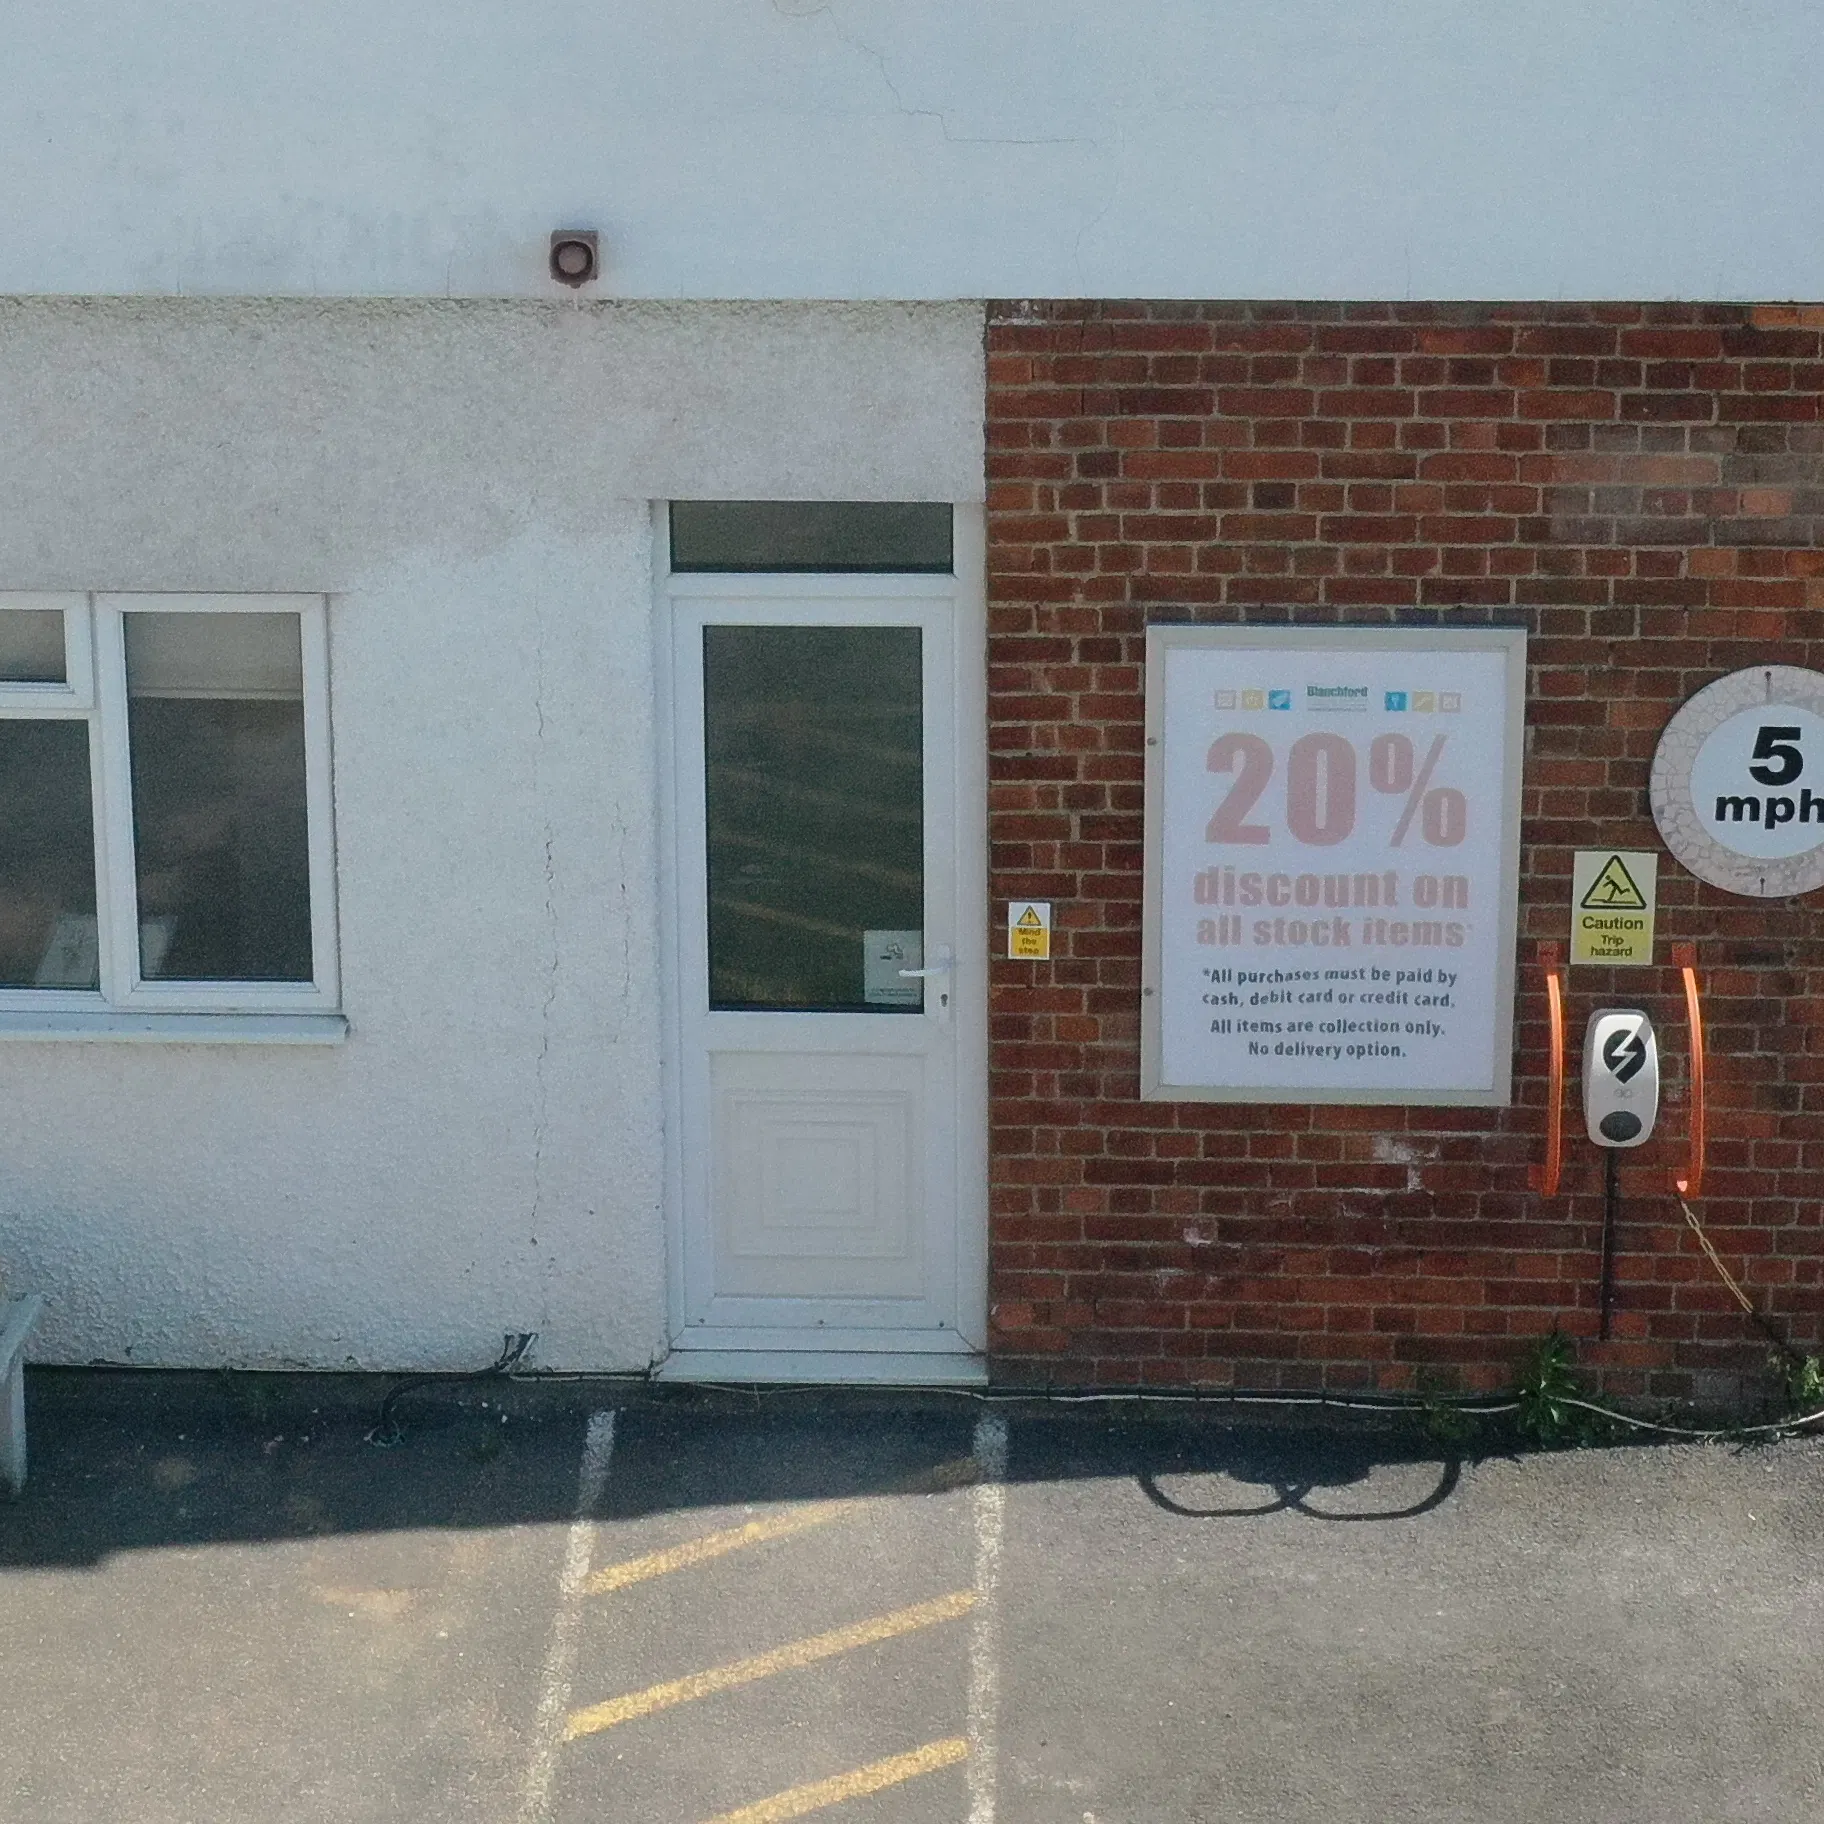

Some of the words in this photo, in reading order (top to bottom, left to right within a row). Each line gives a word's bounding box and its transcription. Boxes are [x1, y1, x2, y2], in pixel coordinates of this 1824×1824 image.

[1749, 726, 1804, 786] 5
[1205, 731, 1467, 847] 20%
[1194, 865, 1399, 908] discount
[1412, 874, 1469, 908] on
[1197, 915, 1242, 946] all
[1253, 916, 1351, 947] stock
[1582, 916, 1644, 931] Caution
[1601, 934, 1624, 947] Trip
[1590, 946, 1633, 957] hazard
[1237, 969, 1320, 986] purchases
[1324, 967, 1366, 980] must
[1370, 965, 1391, 981] be
[1396, 967, 1433, 985] paid
[1437, 968, 1457, 987] by
[1202, 991, 1244, 1007] cash,
[1249, 989, 1292, 1005] debit
[1298, 988, 1333, 1004] card
[1337, 992, 1355, 1004] or
[1359, 990, 1409, 1005] credit
[1413, 992, 1455, 1008] card.
[1210, 1018, 1232, 1034] All
[1236, 1018, 1282, 1033] items
[1286, 1020, 1314, 1033] are
[1319, 1018, 1400, 1033] collection
[1404, 1019, 1445, 1037] only.
[1248, 1040, 1269, 1055] No
[1274, 1040, 1342, 1060] delivery
[1346, 1040, 1407, 1059] option.
